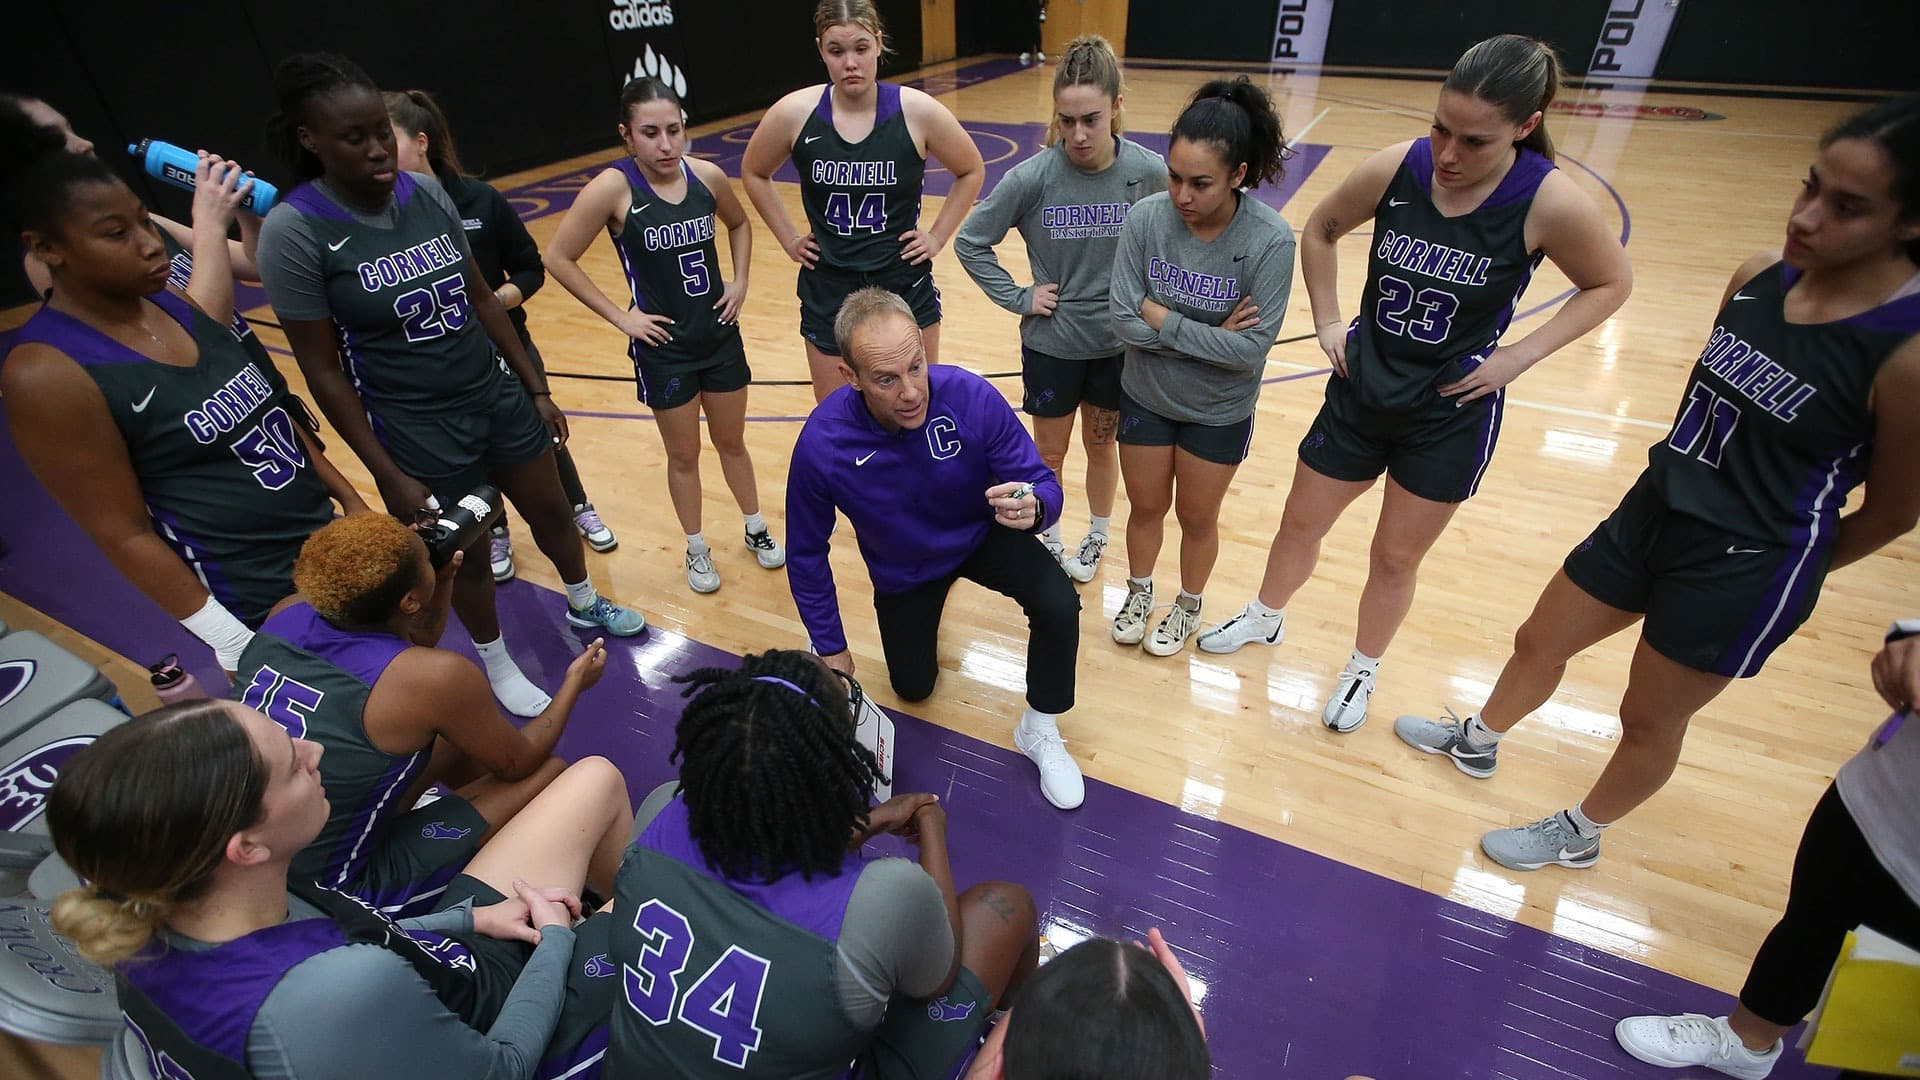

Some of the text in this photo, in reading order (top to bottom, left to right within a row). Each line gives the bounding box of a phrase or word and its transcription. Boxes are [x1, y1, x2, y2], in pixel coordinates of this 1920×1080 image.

[609, 1, 674, 31] adidas
[812, 160, 898, 186] CORNELL
[824, 192, 888, 236] 44
[357, 233, 463, 292] CORNELL
[678, 249, 711, 297] 5
[1147, 256, 1241, 301] CORNELL
[1378, 229, 1493, 286] CORNELL
[393, 272, 468, 342] 25
[1376, 274, 1460, 345] 23
[1699, 325, 1818, 424] CORNELL
[229, 406, 305, 491] 50
[926, 415, 961, 460] C
[1668, 380, 1742, 470] 11
[241, 664, 325, 740] 15
[623, 898, 772, 1069] 34
